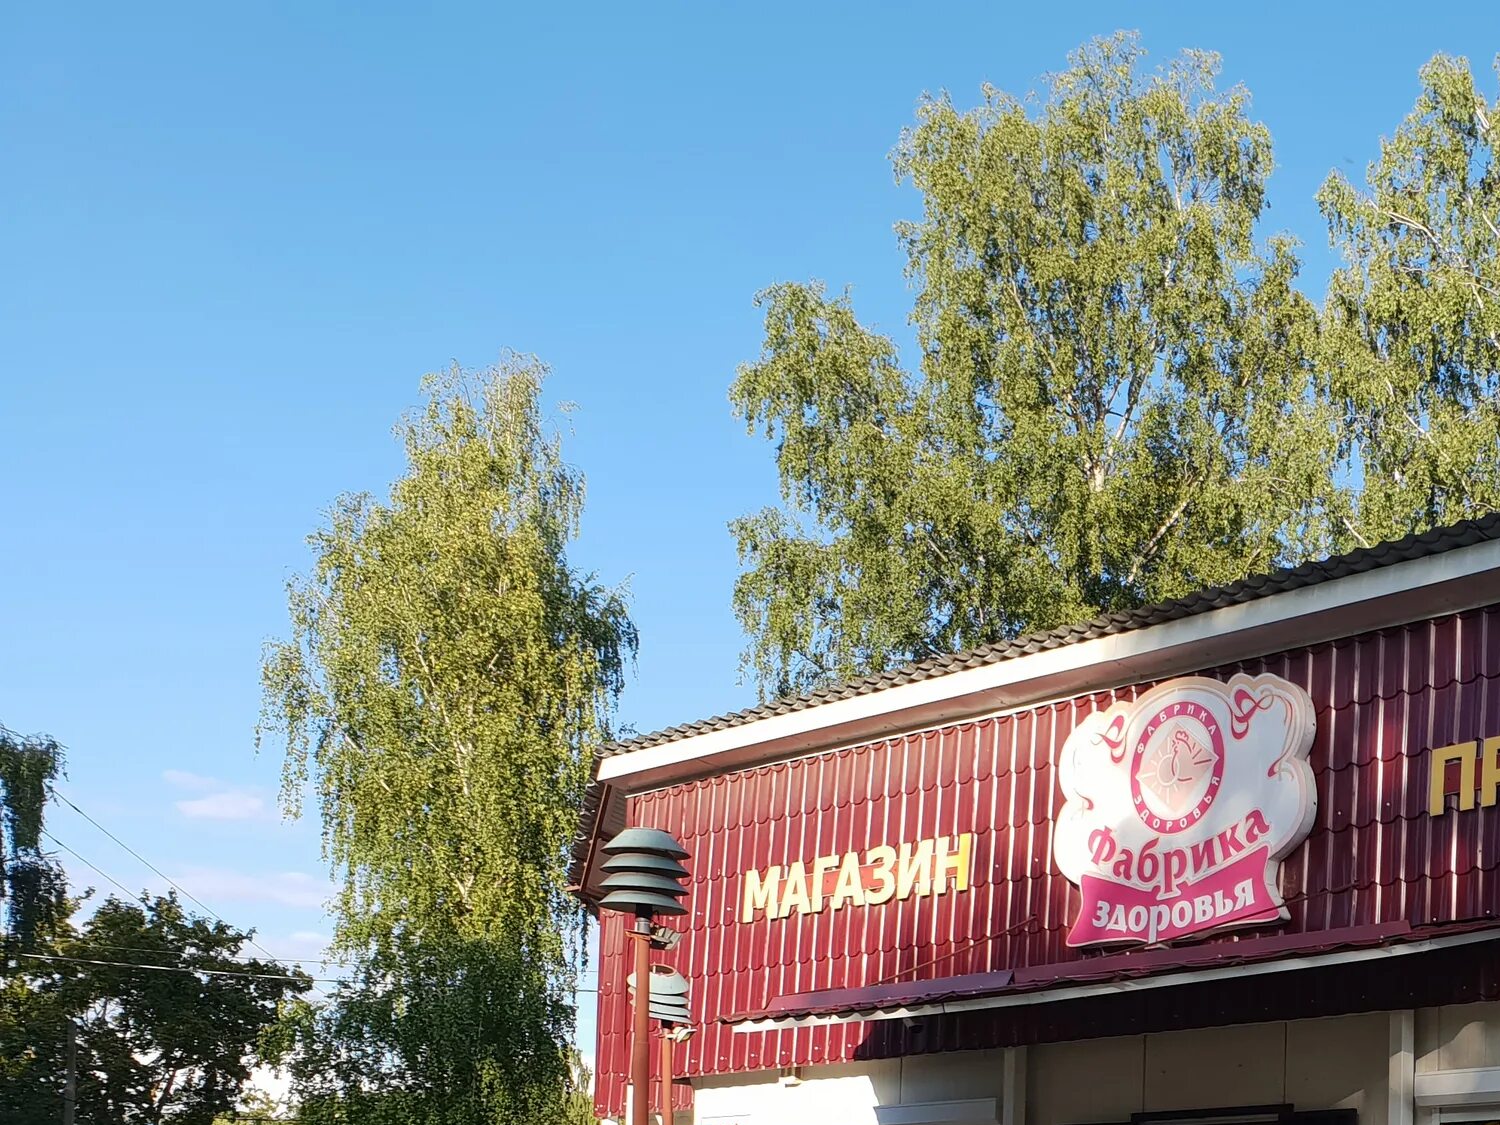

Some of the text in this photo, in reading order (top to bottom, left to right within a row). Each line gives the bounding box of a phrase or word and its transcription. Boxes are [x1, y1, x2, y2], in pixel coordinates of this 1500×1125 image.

[1136, 704, 1216, 753] ФАБРИКА
[1133, 776, 1220, 832] ЗДОРОВЬЯ
[742, 832, 972, 924] МАГАЗИН
[1087, 809, 1270, 893] Фабрика
[1091, 878, 1256, 944] здоровья
